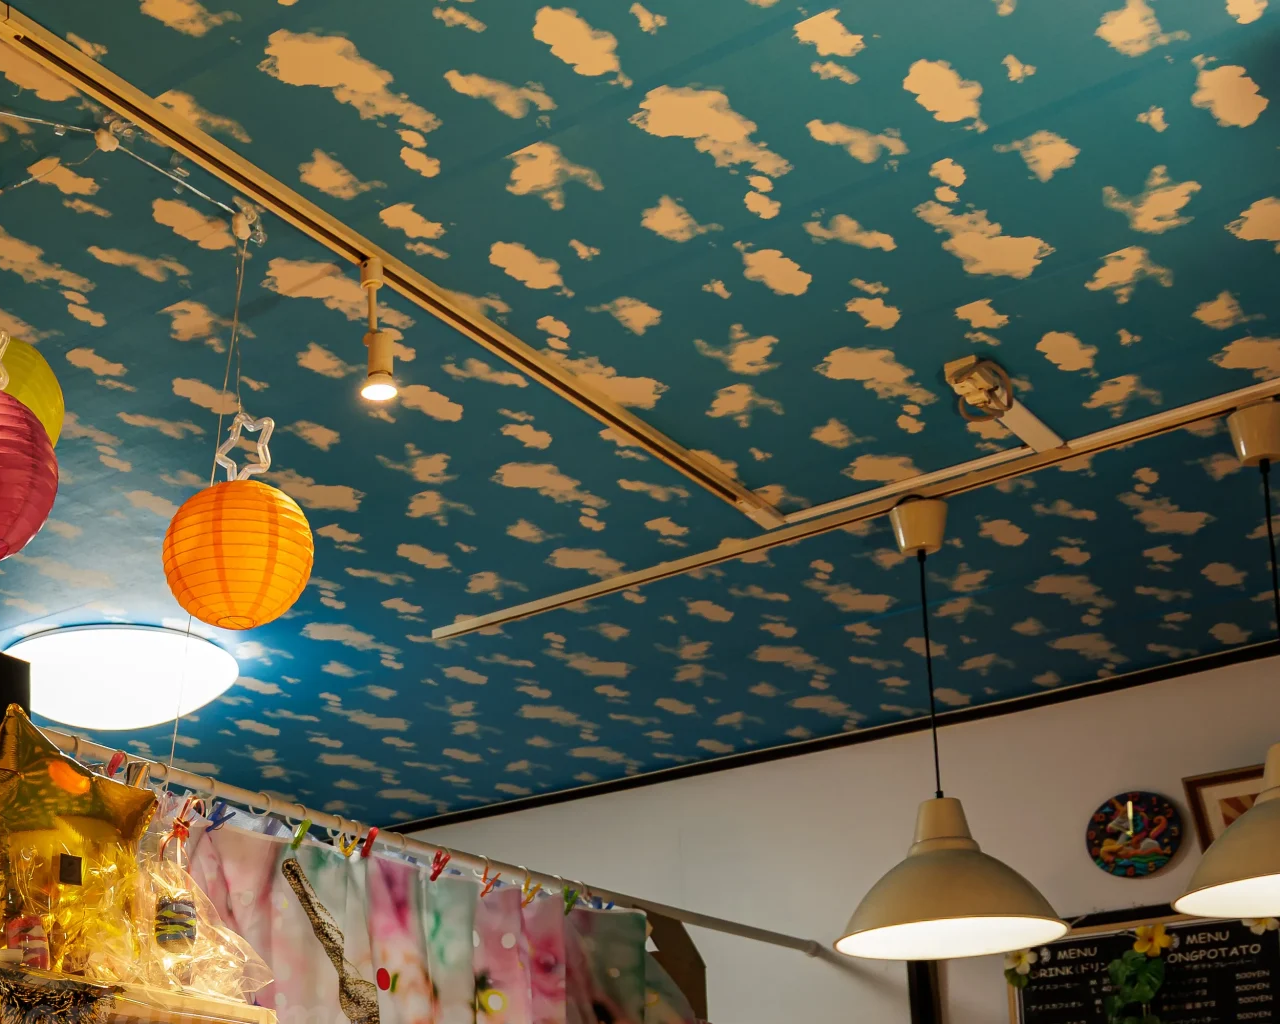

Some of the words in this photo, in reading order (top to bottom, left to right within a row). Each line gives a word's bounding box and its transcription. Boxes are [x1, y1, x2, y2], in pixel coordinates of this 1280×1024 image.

[1186, 930, 1230, 944] MENU
[1057, 947, 1098, 960] MENU
[1166, 944, 1262, 964] ONGPOTATO
